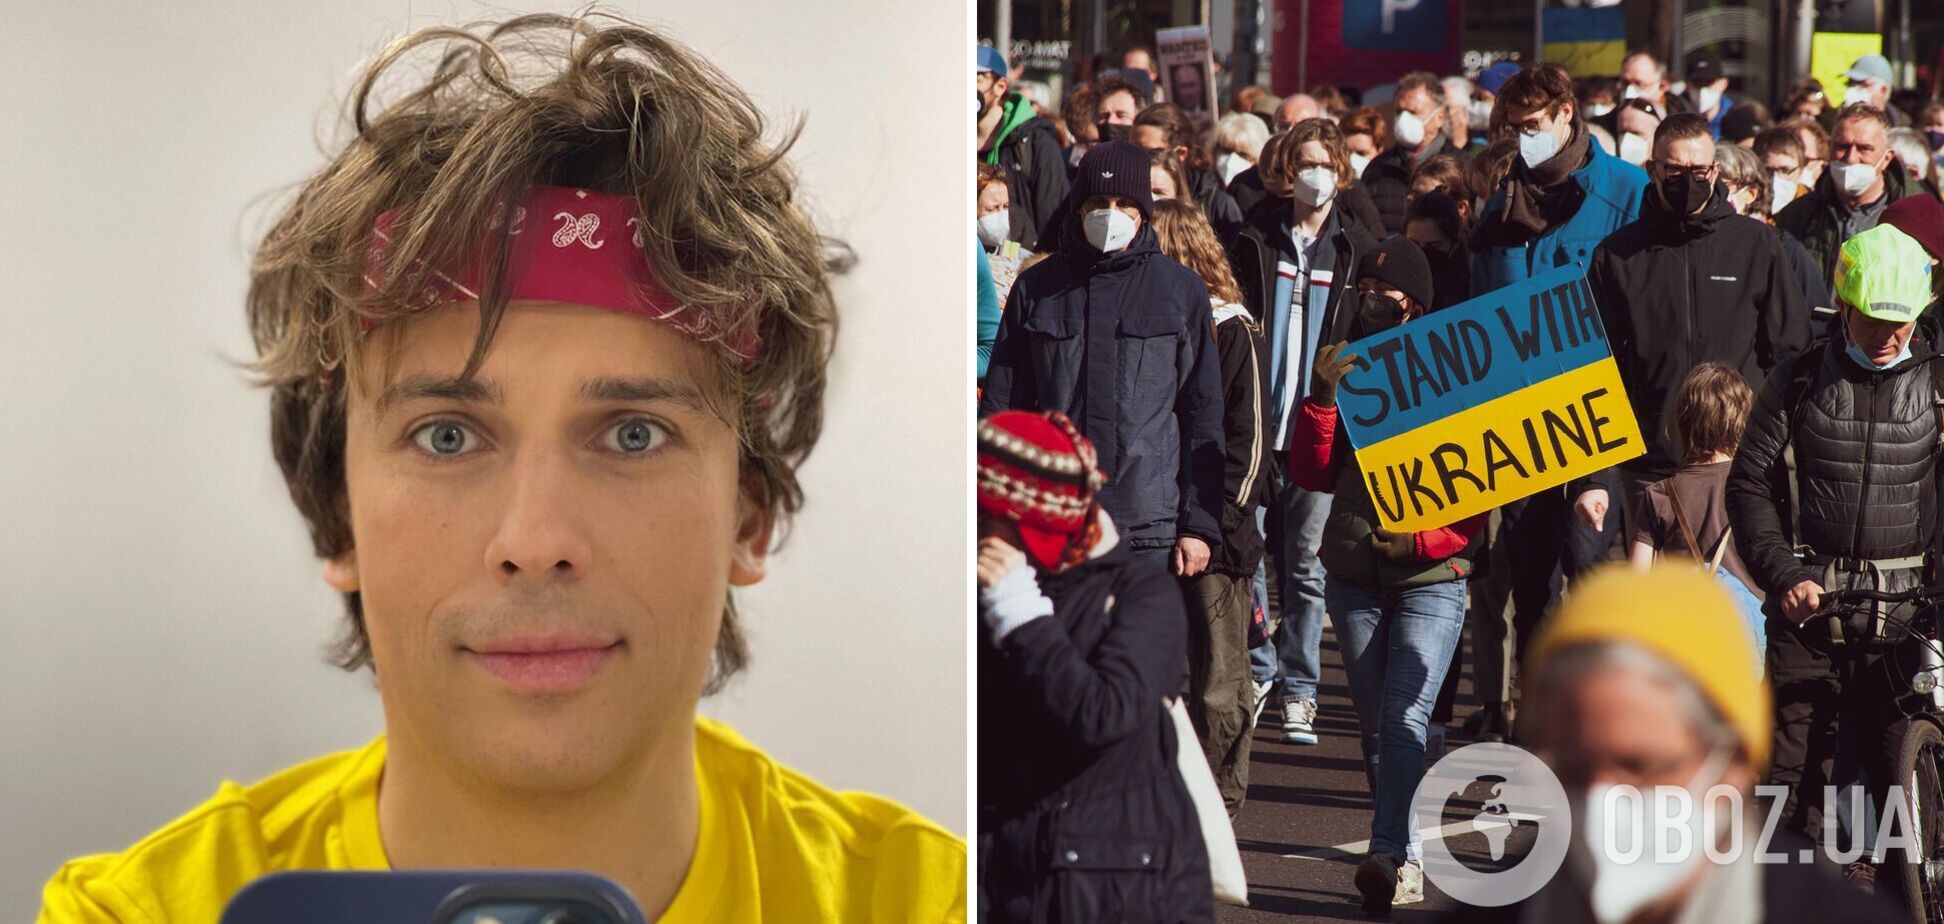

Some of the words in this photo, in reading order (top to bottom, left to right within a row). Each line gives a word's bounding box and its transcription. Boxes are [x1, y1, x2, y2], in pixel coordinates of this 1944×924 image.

[1341, 318, 1493, 428] STAND
[1495, 278, 1605, 363] WITH
[1367, 387, 1629, 523] UKRAINE
